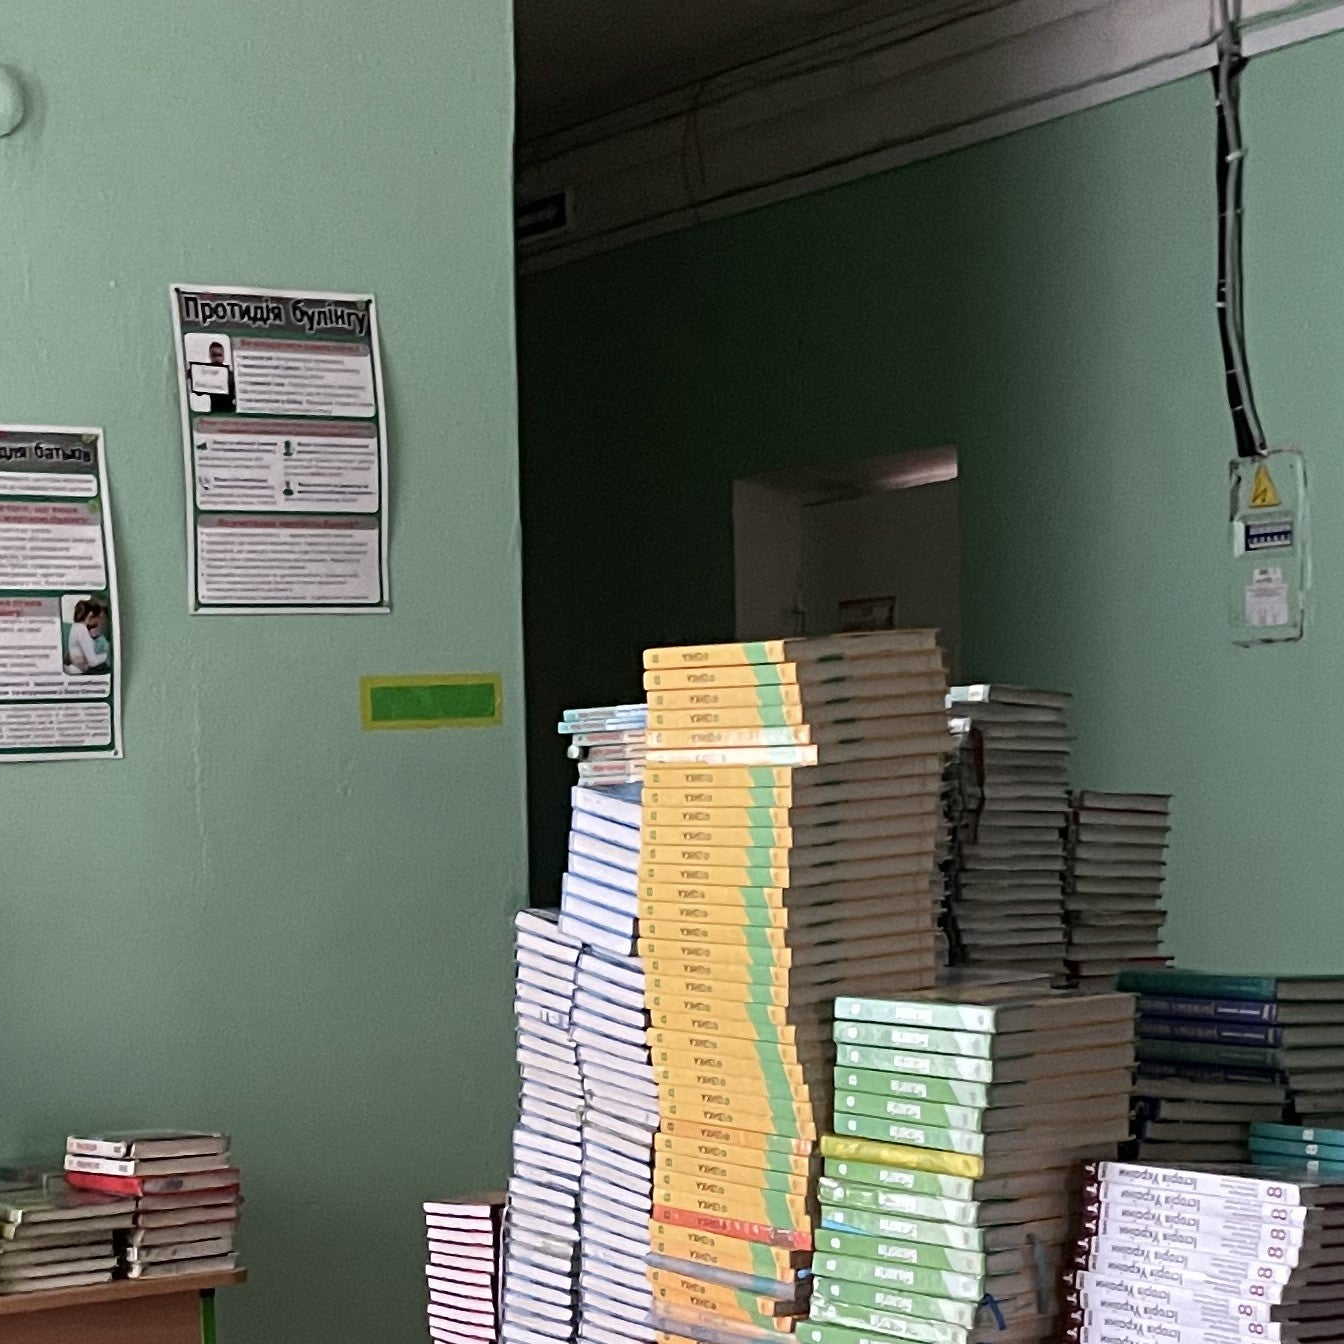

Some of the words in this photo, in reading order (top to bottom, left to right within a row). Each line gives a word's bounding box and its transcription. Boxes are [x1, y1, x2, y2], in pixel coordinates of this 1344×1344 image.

[184, 296, 282, 324] Протидія
[292, 300, 368, 334] булінгу
[1266, 1187, 1282, 1198] 8
[1271, 1208, 1287, 1220] 8
[1271, 1229, 1286, 1240] 8
[1268, 1247, 1283, 1258] 8
[1258, 1267, 1272, 1278] 8
[1249, 1285, 1264, 1296] 8
[1238, 1304, 1252, 1316] 8
[1249, 1323, 1263, 1334] 8
